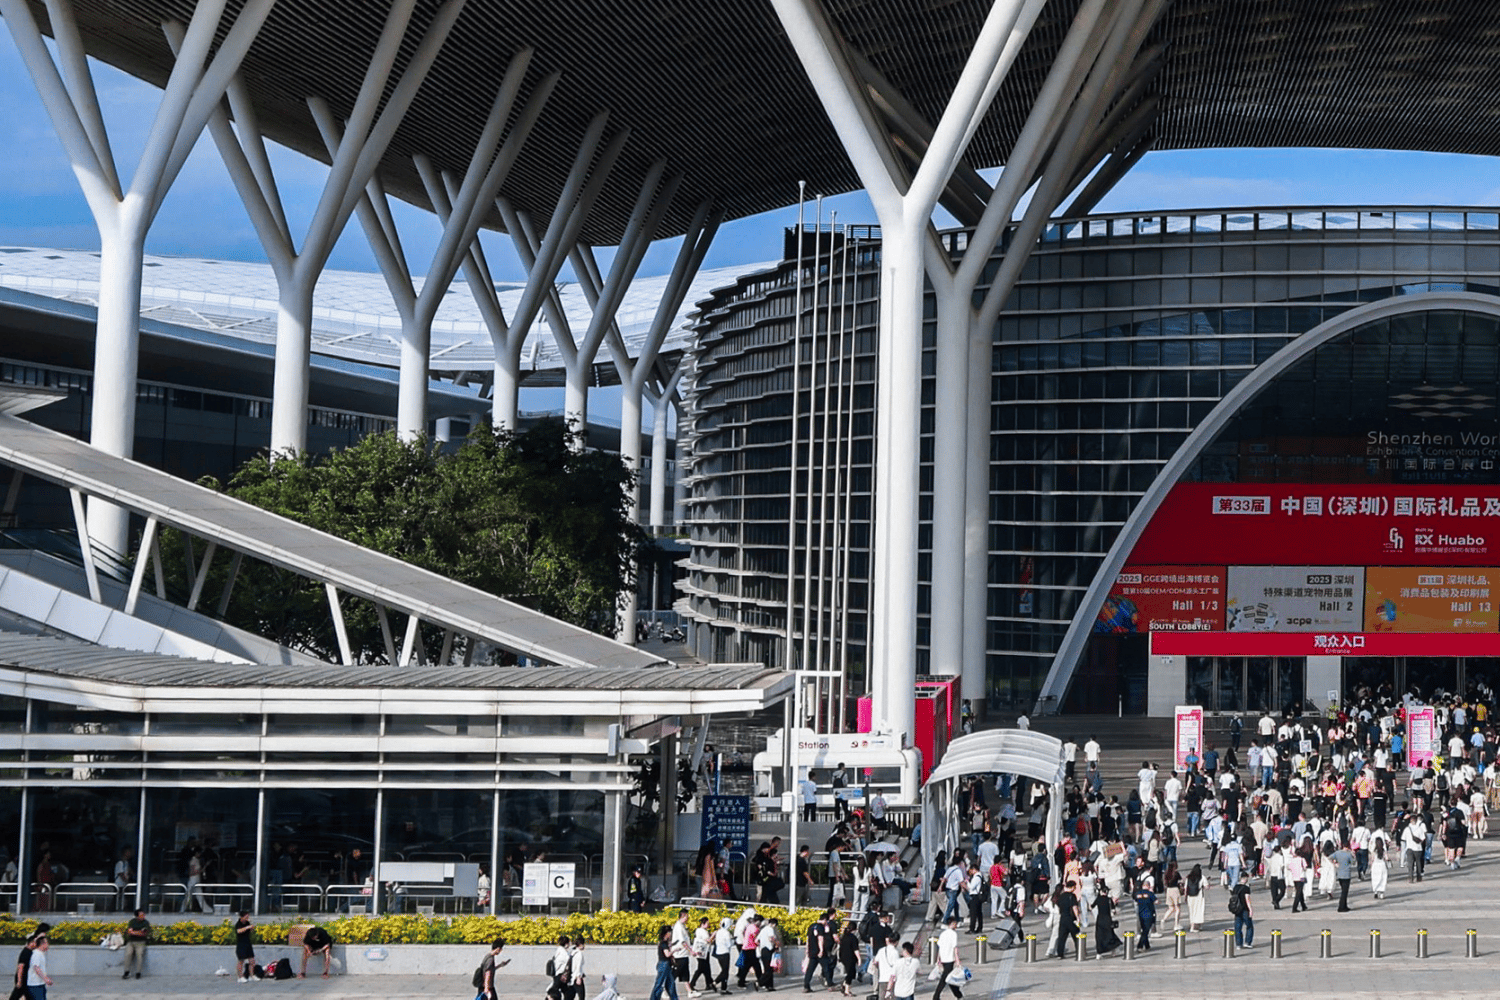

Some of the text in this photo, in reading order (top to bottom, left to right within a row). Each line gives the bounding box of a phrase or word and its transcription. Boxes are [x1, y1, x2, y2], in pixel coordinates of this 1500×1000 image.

[1367, 431, 1453, 445] Shenzhen
[1366, 446, 1414, 456] Exhibition
[1425, 447, 1480, 456] Convention
[1218, 497, 1265, 513] 第33届
[1414, 534, 1485, 546] RX Huabo
[1334, 575, 1354, 585] 深圳
[1264, 587, 1353, 598] 特殊渠道宠物用品展
[1172, 600, 1218, 611] Hall 1/3
[1319, 601, 1354, 611] Hall 2
[1450, 602, 1491, 612] Hall 13
[1148, 623, 1175, 631] SOUTH
[1314, 634, 1365, 648] 观众入口
[798, 740, 830, 750] Station
